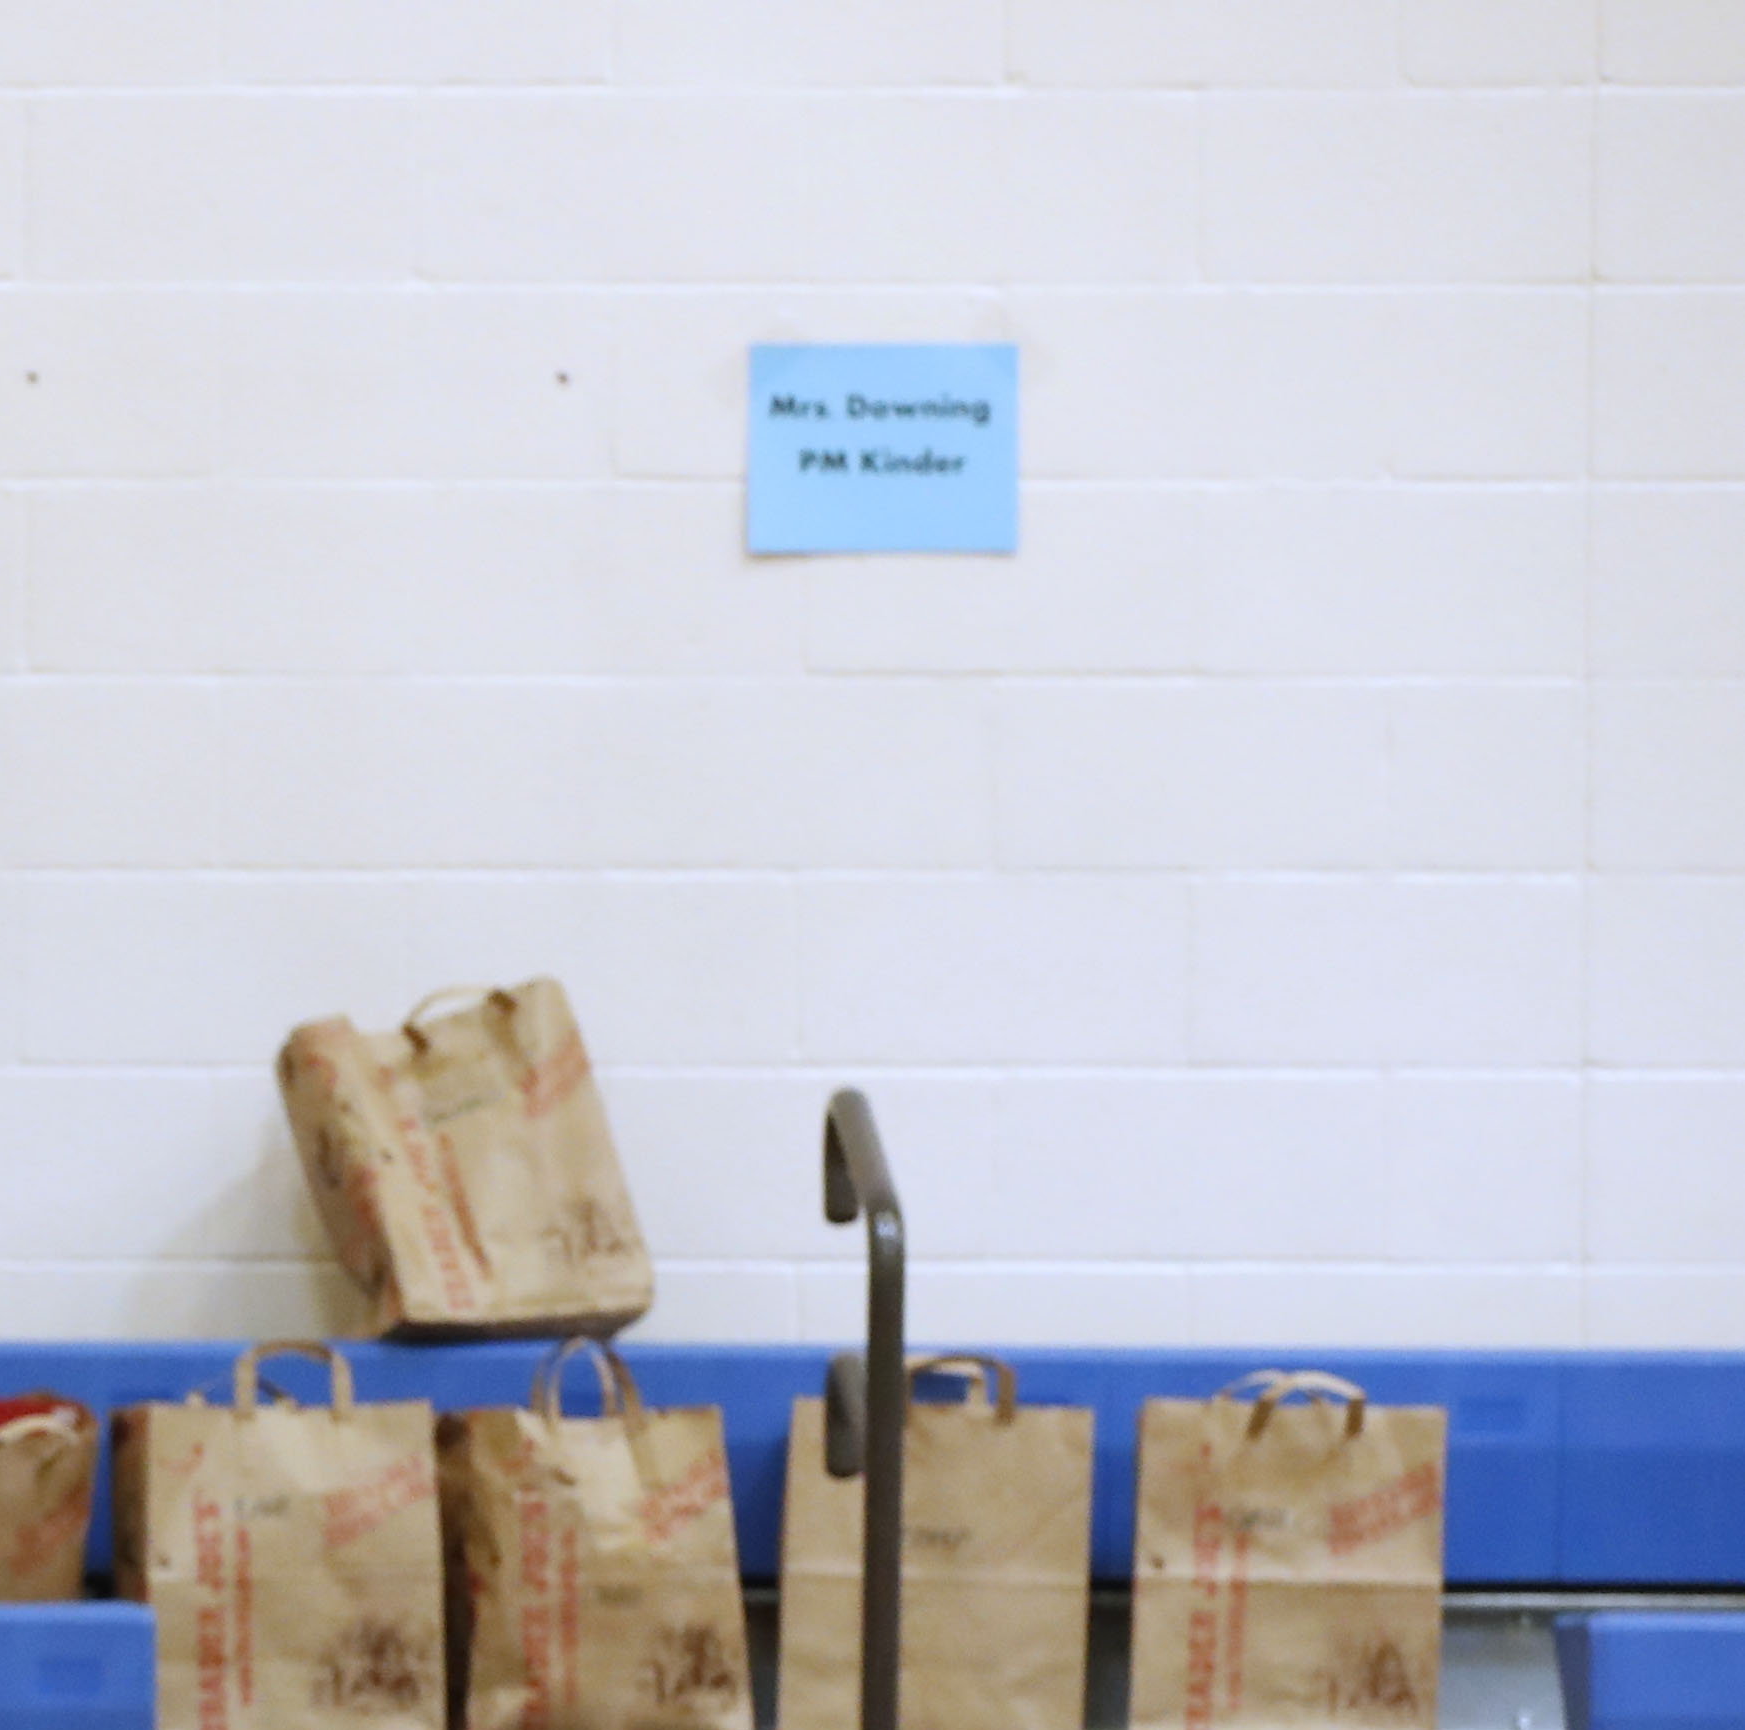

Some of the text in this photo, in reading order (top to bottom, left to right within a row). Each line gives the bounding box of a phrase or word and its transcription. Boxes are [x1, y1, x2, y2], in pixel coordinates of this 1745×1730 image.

[845, 391, 992, 427] Downing
[799, 446, 965, 475] PM Kinder
